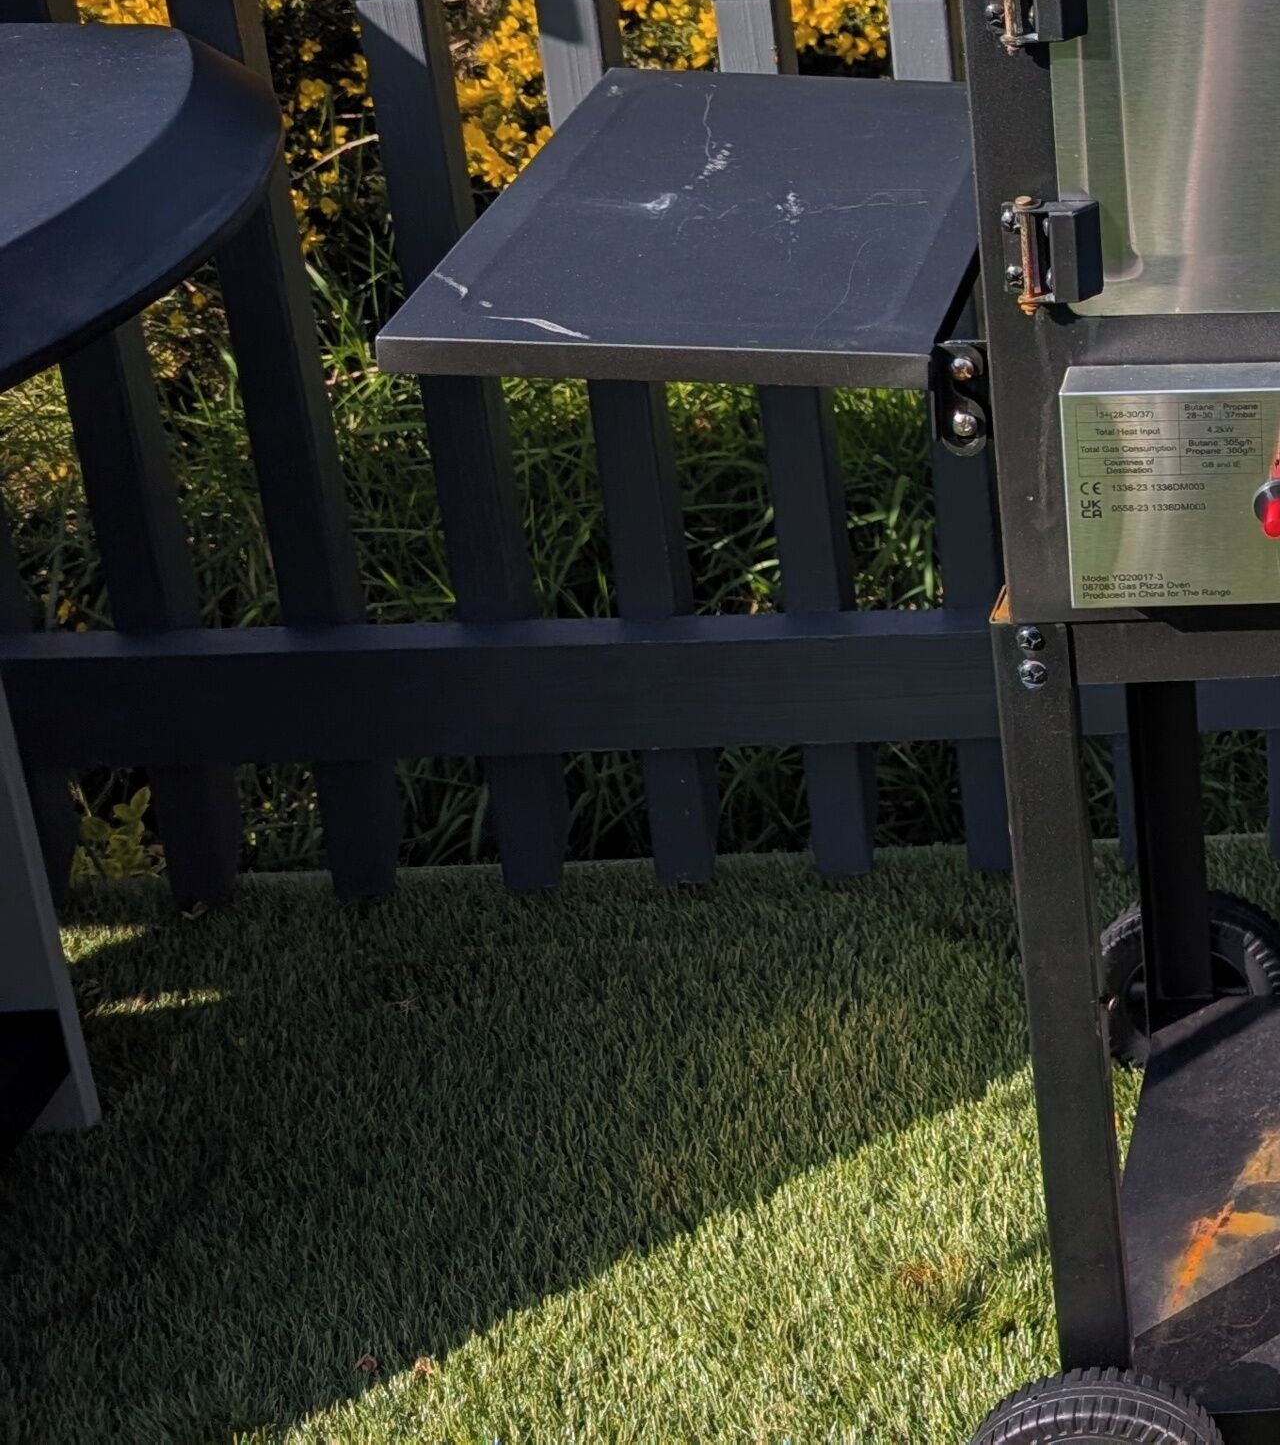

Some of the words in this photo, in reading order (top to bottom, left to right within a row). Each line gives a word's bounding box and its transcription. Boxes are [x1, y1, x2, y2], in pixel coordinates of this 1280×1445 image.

[1223, 402, 1258, 412] Propane
[1140, 427, 1160, 436] Input
[1080, 445, 1100, 453] Total
[1121, 444, 1177, 454] Consumption
[1080, 499, 1102, 509] UK
[1081, 509, 1103, 519] CA
[1118, 582, 1137, 590] Gas
[1139, 581, 1164, 590] Pizza
[1167, 581, 1191, 589] Oven
[1082, 591, 1126, 600] Produced
[1138, 589, 1165, 598] China
